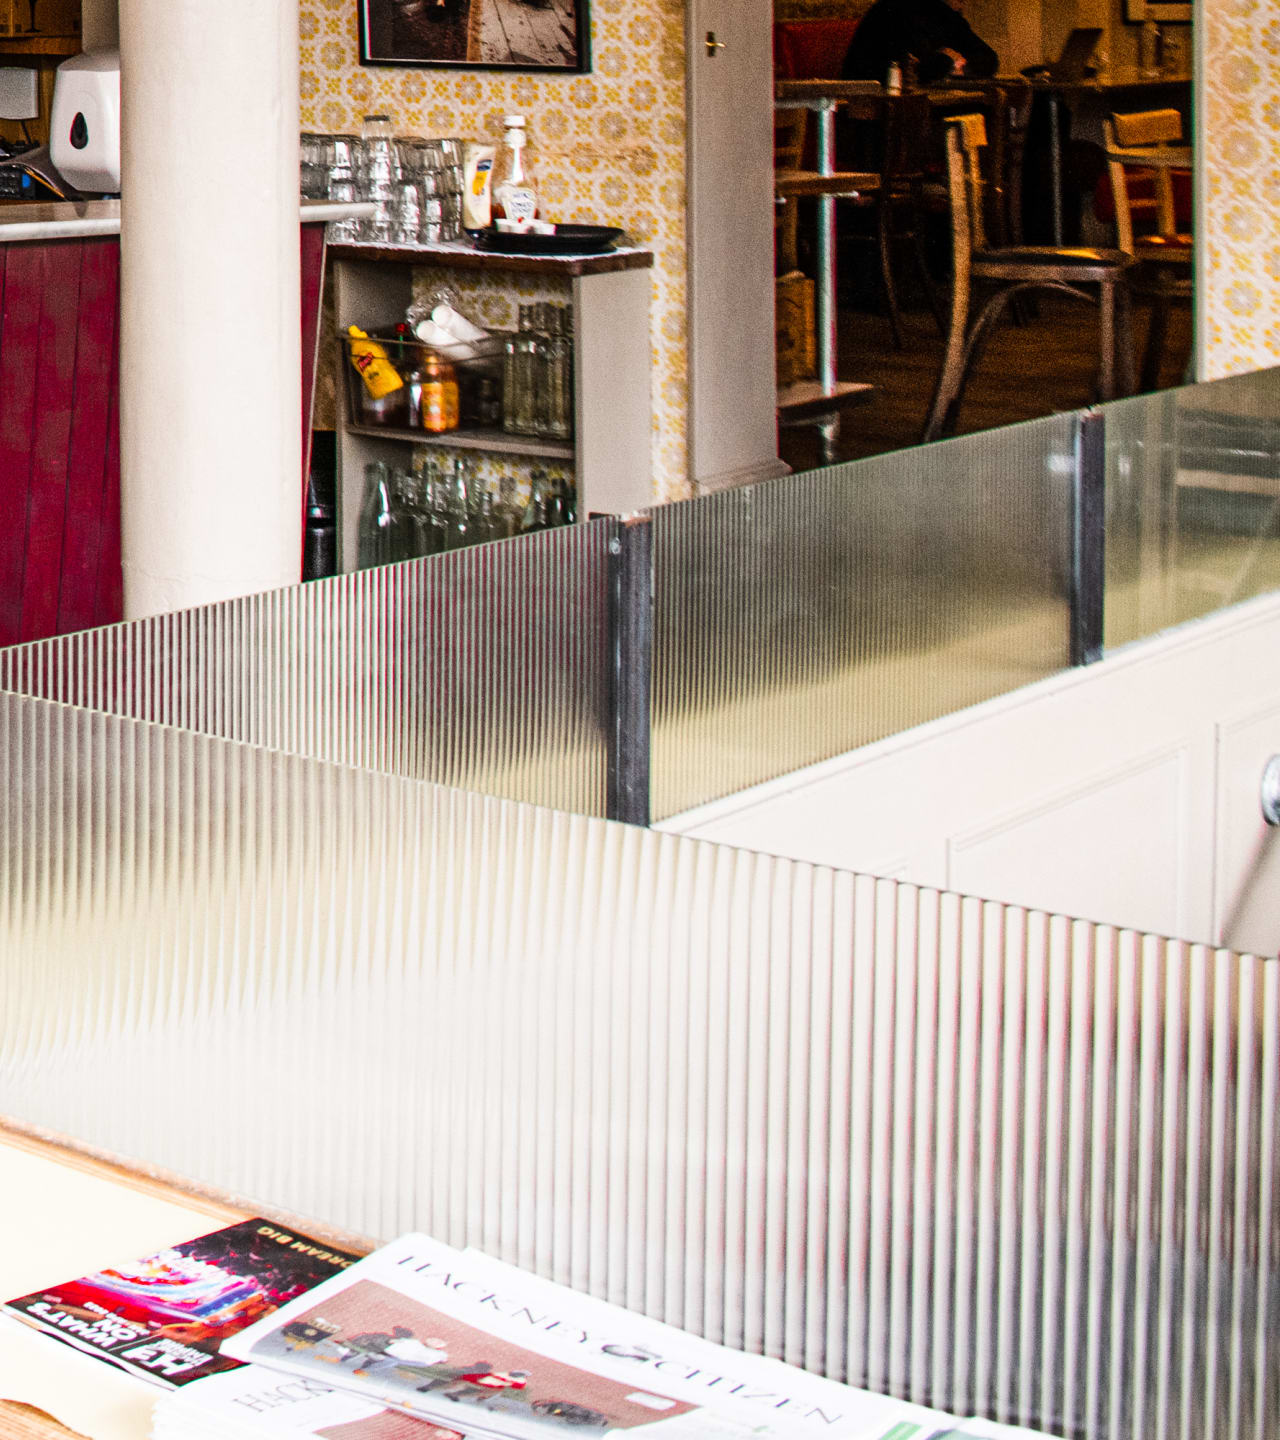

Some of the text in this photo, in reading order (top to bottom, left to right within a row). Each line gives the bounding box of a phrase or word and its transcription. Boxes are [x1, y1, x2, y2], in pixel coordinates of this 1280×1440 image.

[256, 1225, 294, 1245] BIG
[26, 1301, 119, 1348] WHAT'S
[91, 1318, 138, 1341] ON
[397, 1255, 842, 1425] HACKNEY CITIZEN
